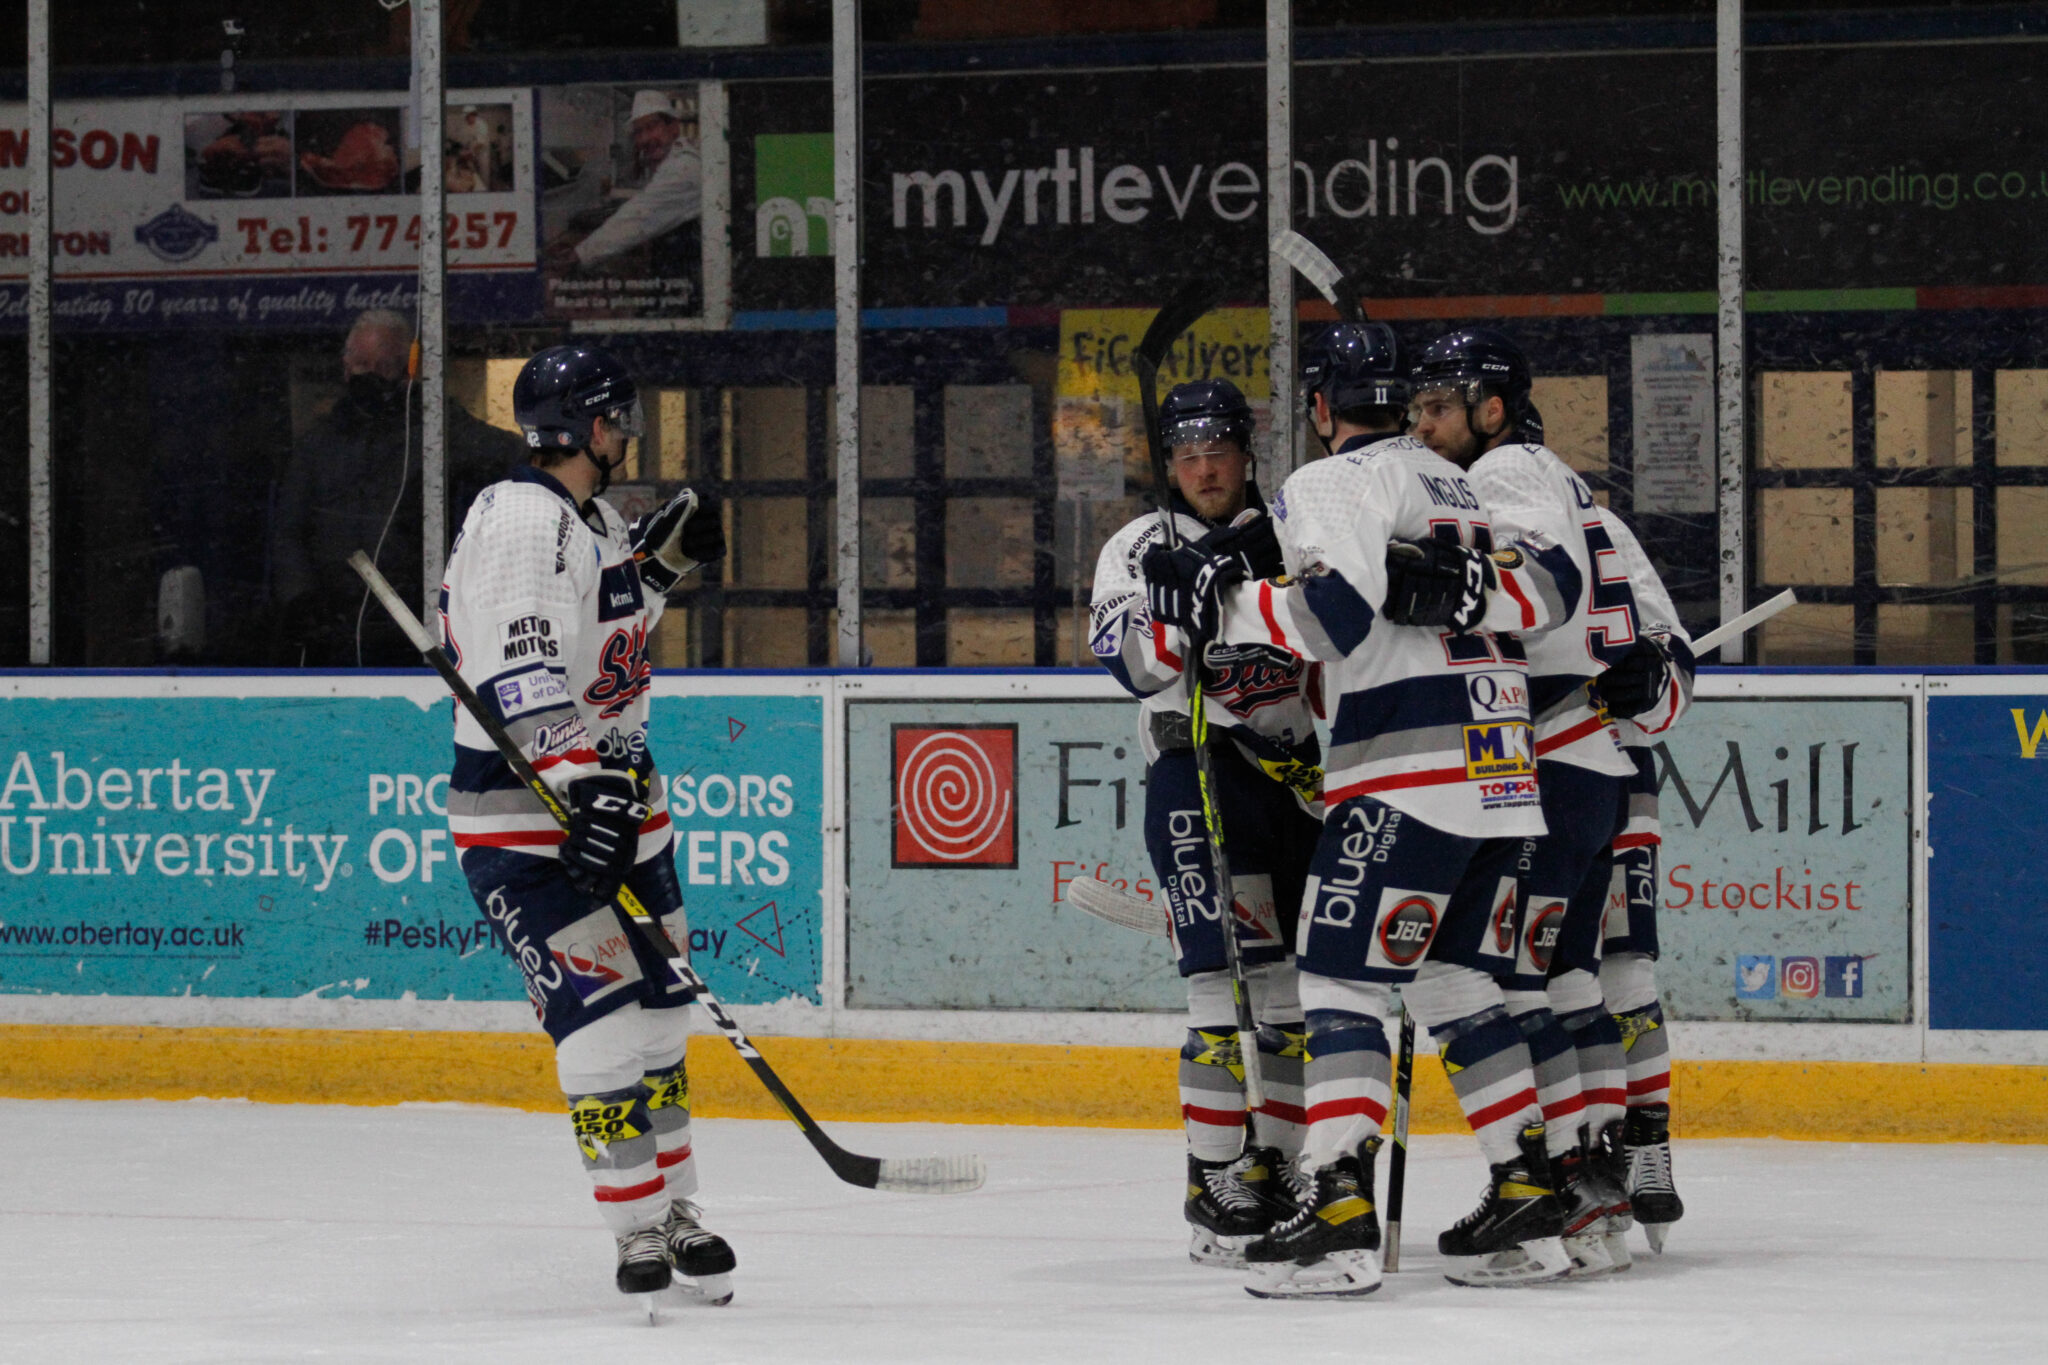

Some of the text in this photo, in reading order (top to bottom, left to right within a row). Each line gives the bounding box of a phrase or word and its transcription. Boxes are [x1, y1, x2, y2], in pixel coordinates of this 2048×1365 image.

[892, 136, 1519, 246] myrtlevending
[1557, 166, 2048, 211] www.mtlevending.co.
[238, 216, 327, 253] Tel:
[0, 290, 113, 322] Celating
[122, 288, 155, 314] 80
[159, 296, 220, 317] years
[227, 287, 252, 320] of
[257, 286, 337, 319] quality
[1374, 387, 1389, 404] 11
[1416, 471, 1479, 511] INGLIS
[2, 751, 276, 825] Abertay
[1475, 762, 1518, 775] BUILDING
[1479, 780, 1537, 797] TOPPE
[1652, 740, 1863, 836] Mill
[1373, 806, 1402, 864] Digital
[1168, 810, 1221, 925] blue2
[1314, 806, 1386, 929] blue2
[1664, 863, 1863, 912] Stockist
[1167, 874, 1190, 928] Digital
[486, 884, 563, 1003] blue2
[1387, 919, 1433, 945] JBC
